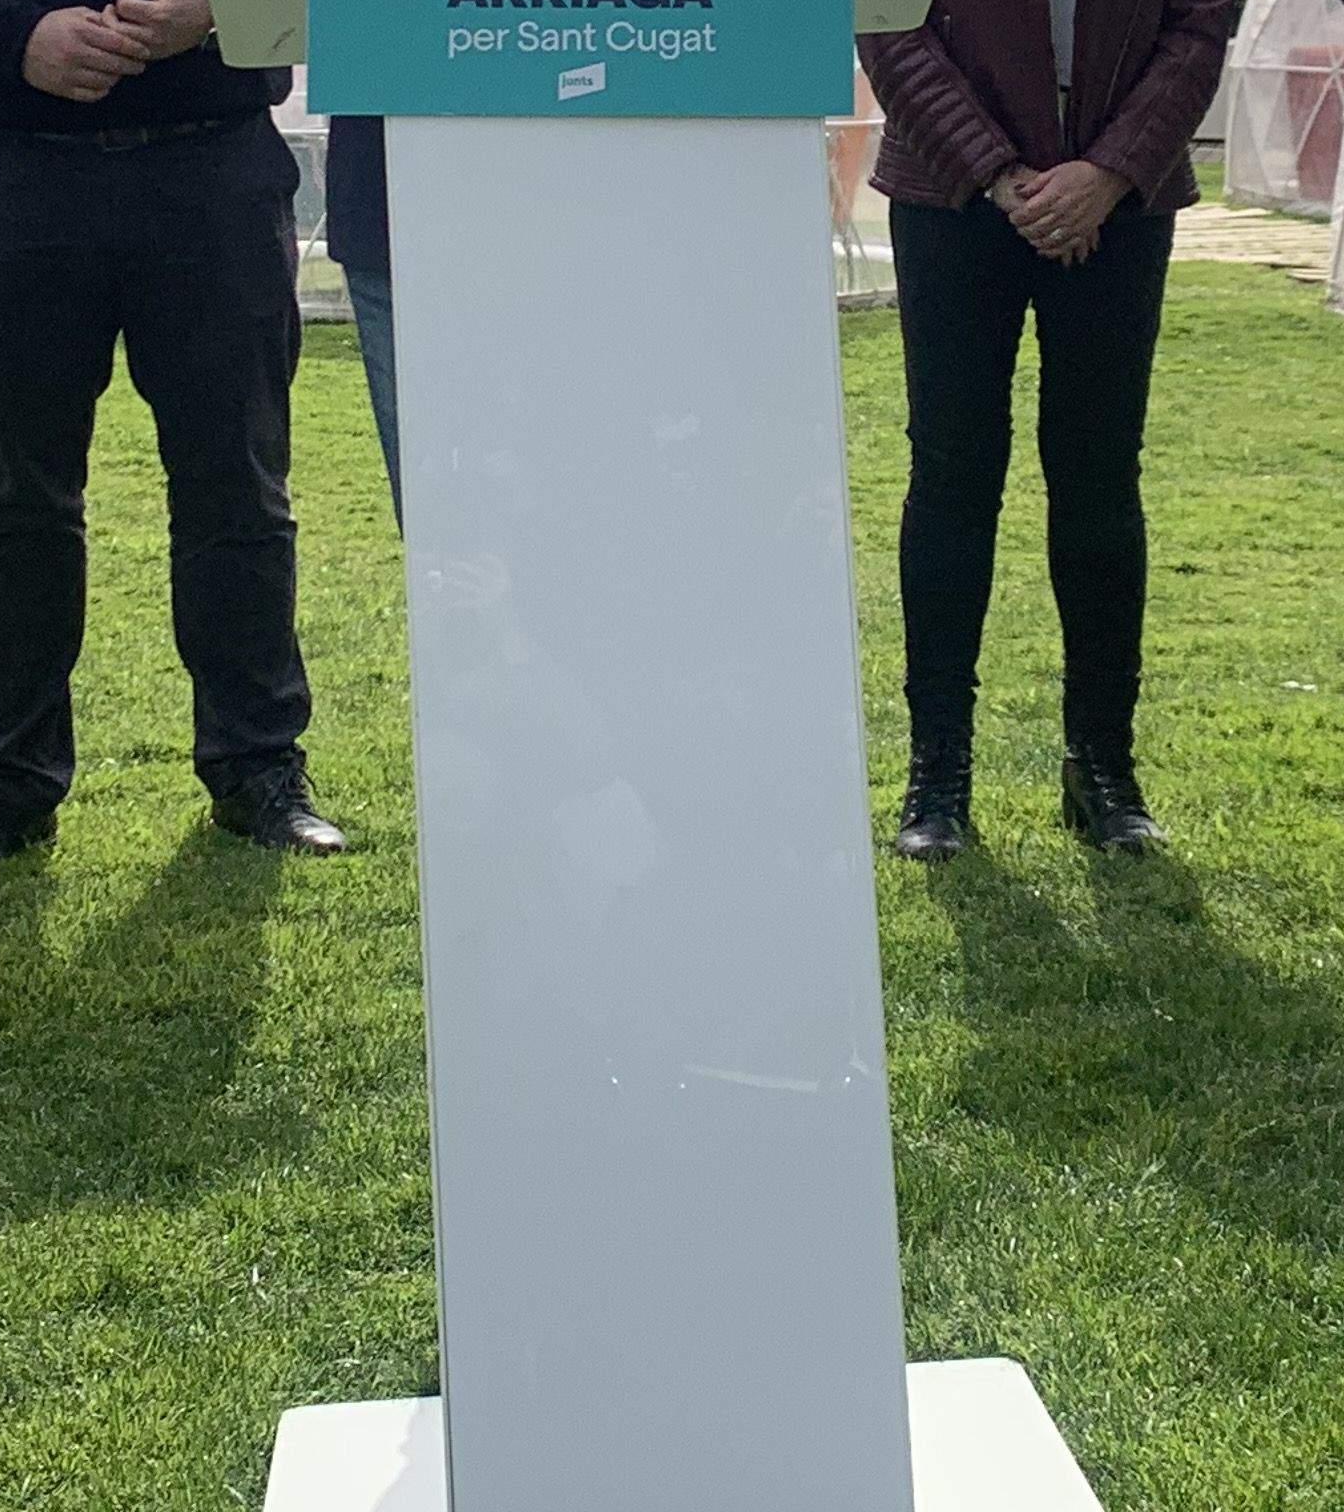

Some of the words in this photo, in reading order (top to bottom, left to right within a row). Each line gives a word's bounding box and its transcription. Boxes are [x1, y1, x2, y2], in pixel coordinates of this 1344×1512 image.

[448, 28, 510, 59] per
[517, 21, 598, 52] Sant
[605, 21, 717, 60] Cugat
